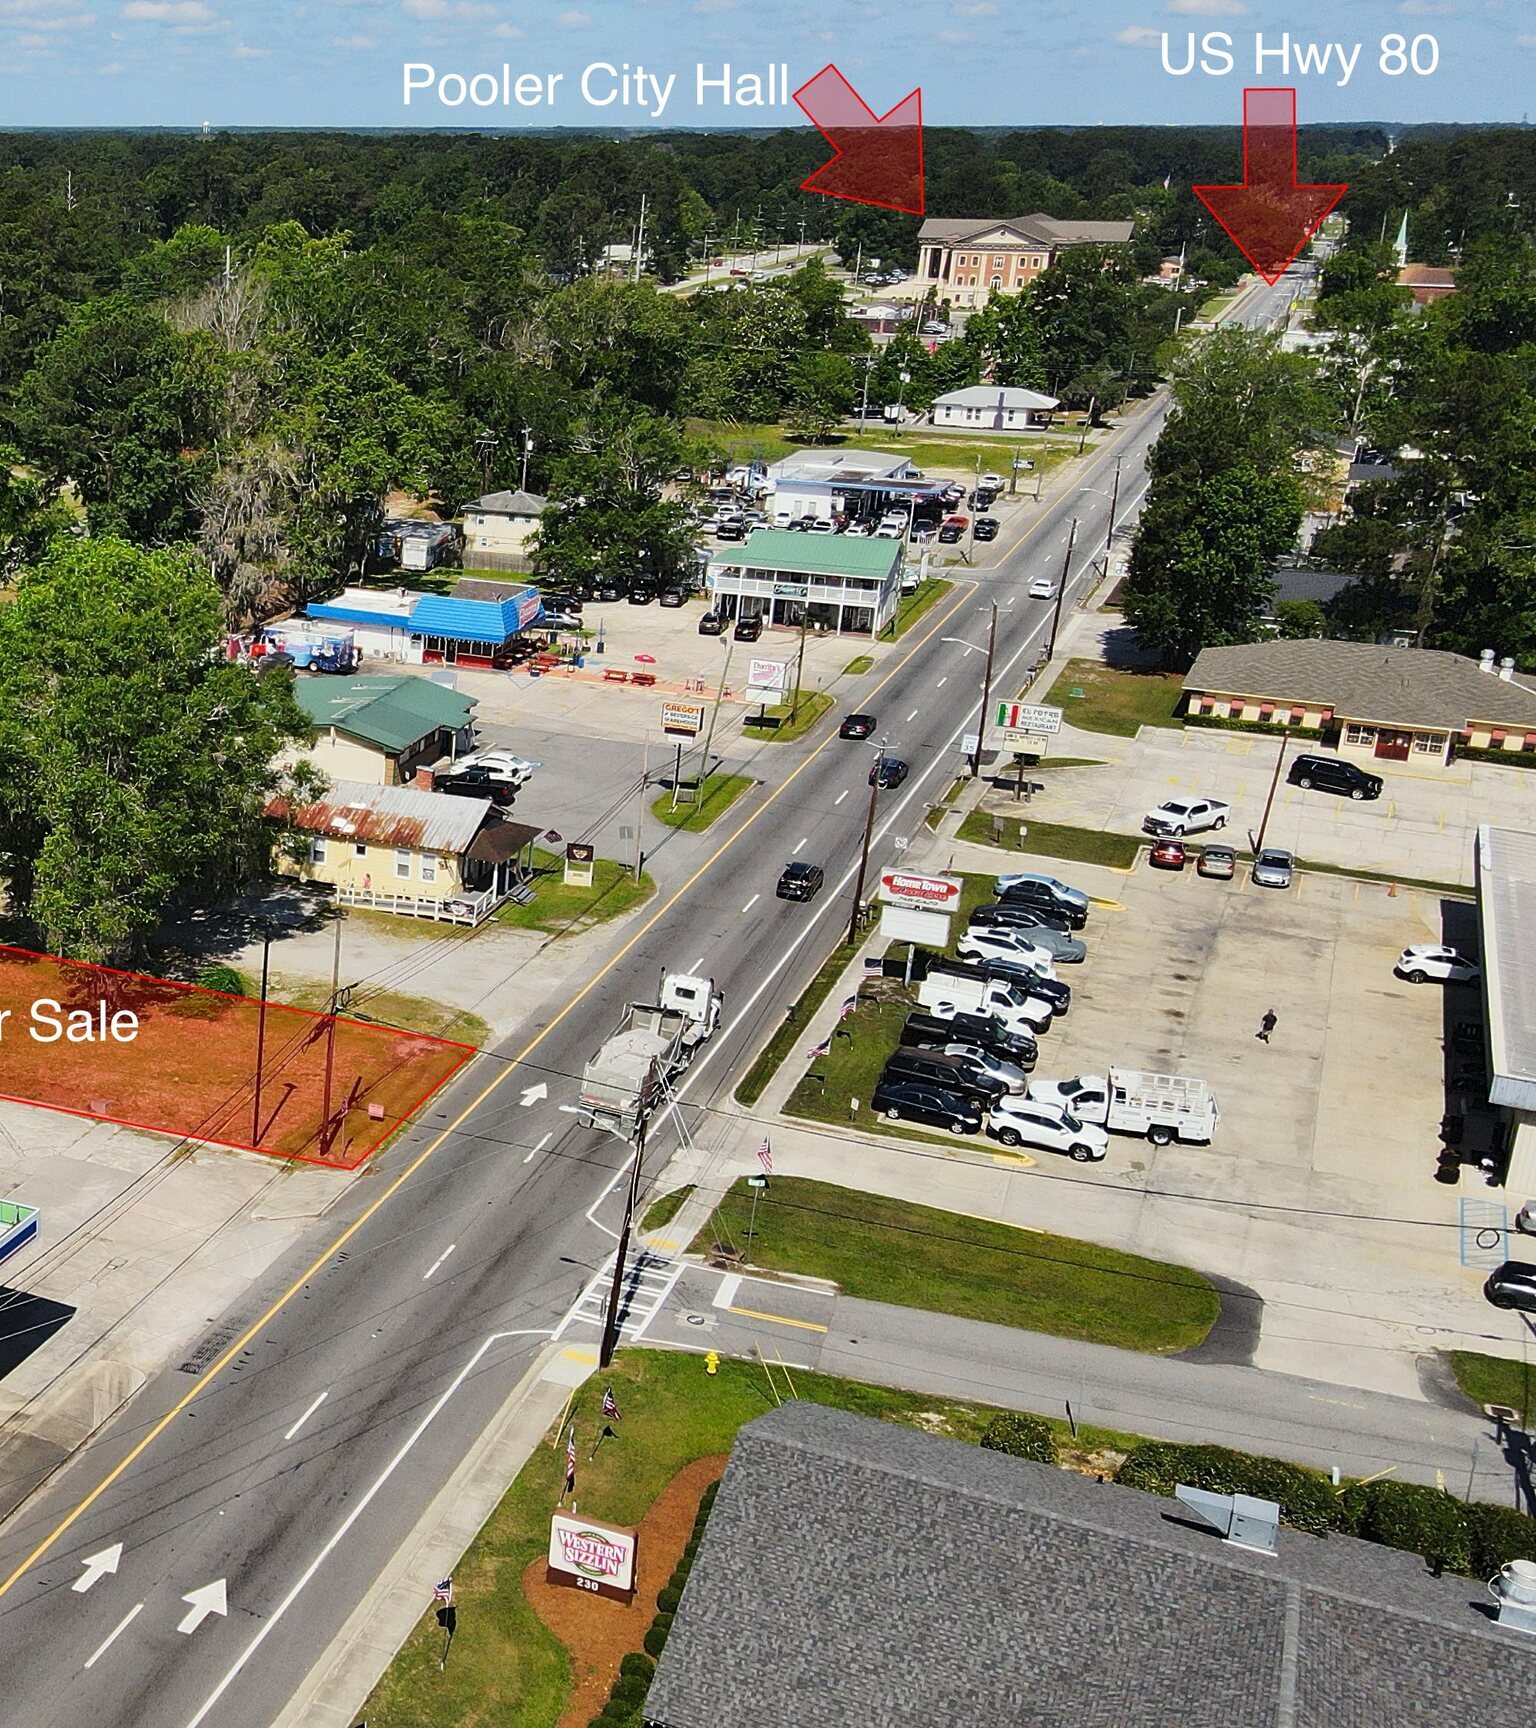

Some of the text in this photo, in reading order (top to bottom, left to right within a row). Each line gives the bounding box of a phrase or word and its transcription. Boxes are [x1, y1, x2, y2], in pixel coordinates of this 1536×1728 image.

[558, 1528, 626, 1563] WESTERN
[565, 1546, 619, 1576] SIZZLIN
[576, 1577, 599, 1591] 230
